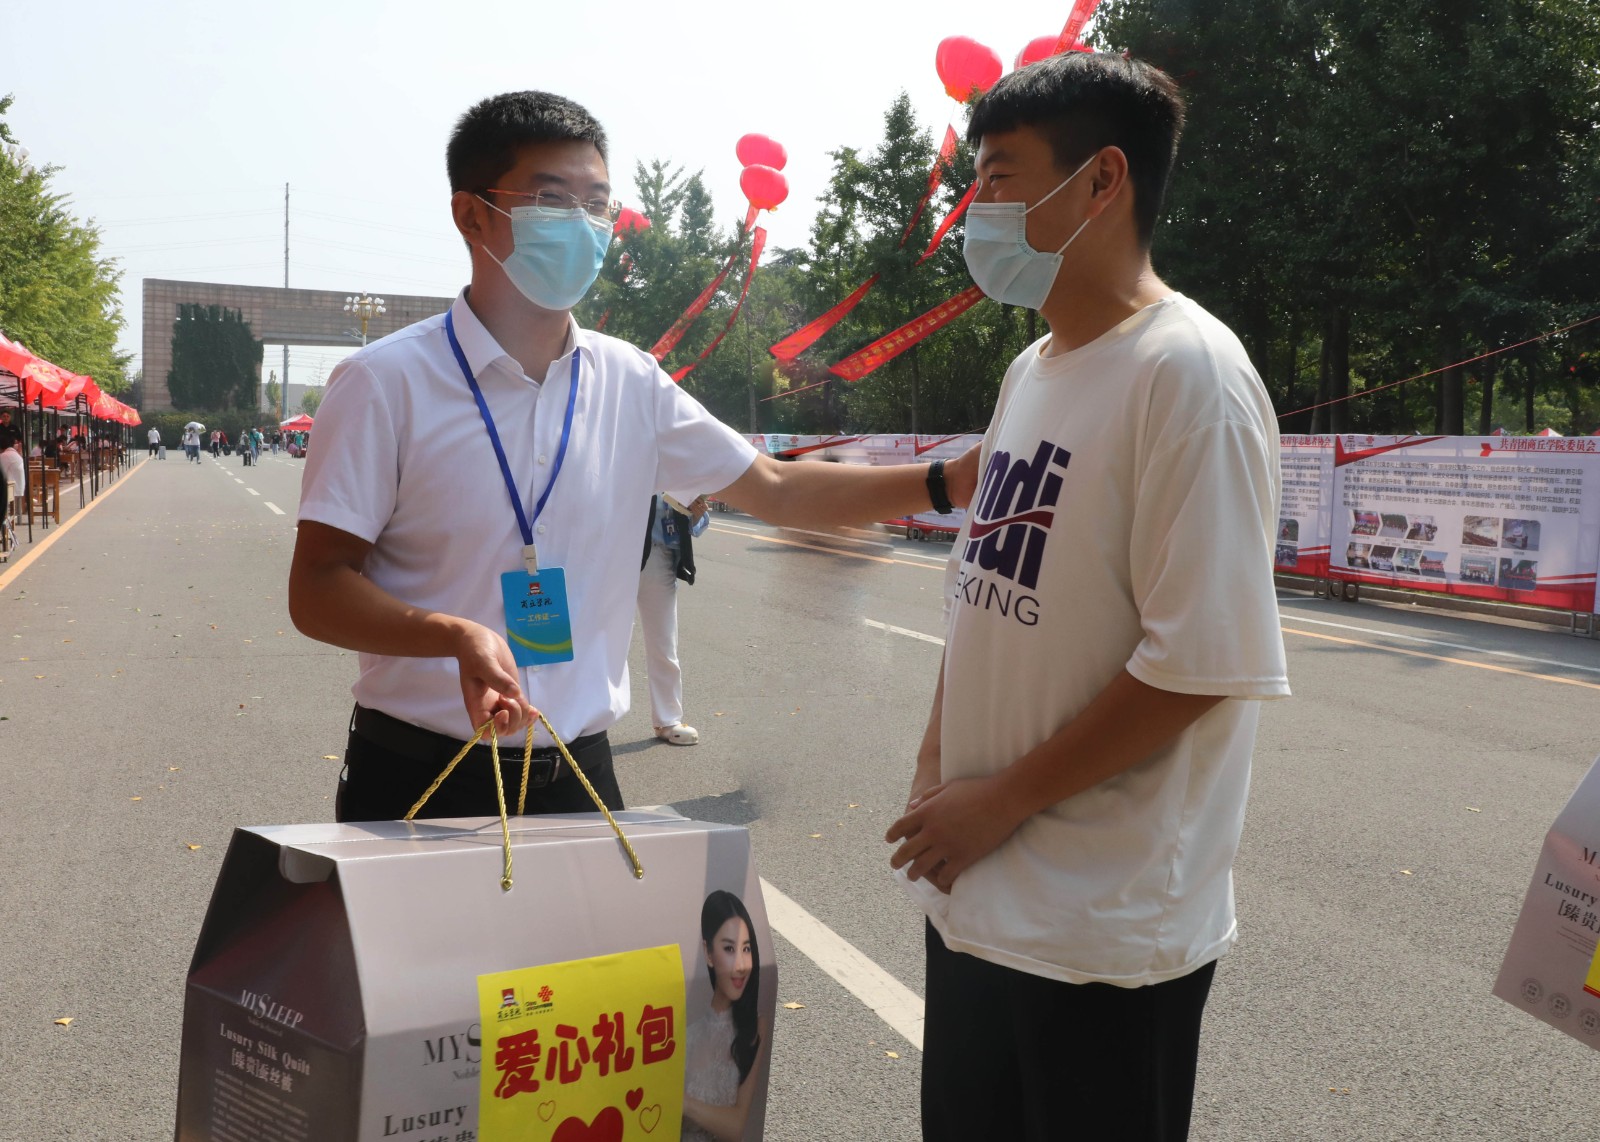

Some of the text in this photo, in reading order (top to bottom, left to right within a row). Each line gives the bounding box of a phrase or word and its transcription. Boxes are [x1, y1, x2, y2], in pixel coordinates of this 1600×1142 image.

[1499, 437, 1597, 452] 共青团商丘学院委员会
[1544, 872, 1599, 907] Lusury
[219, 1022, 254, 1052] Lusury
[257, 1040, 278, 1060] Silk
[282, 1051, 311, 1076] Quilt
[493, 1004, 677, 1100] 爱心礼包
[383, 1104, 468, 1137] Lusury
